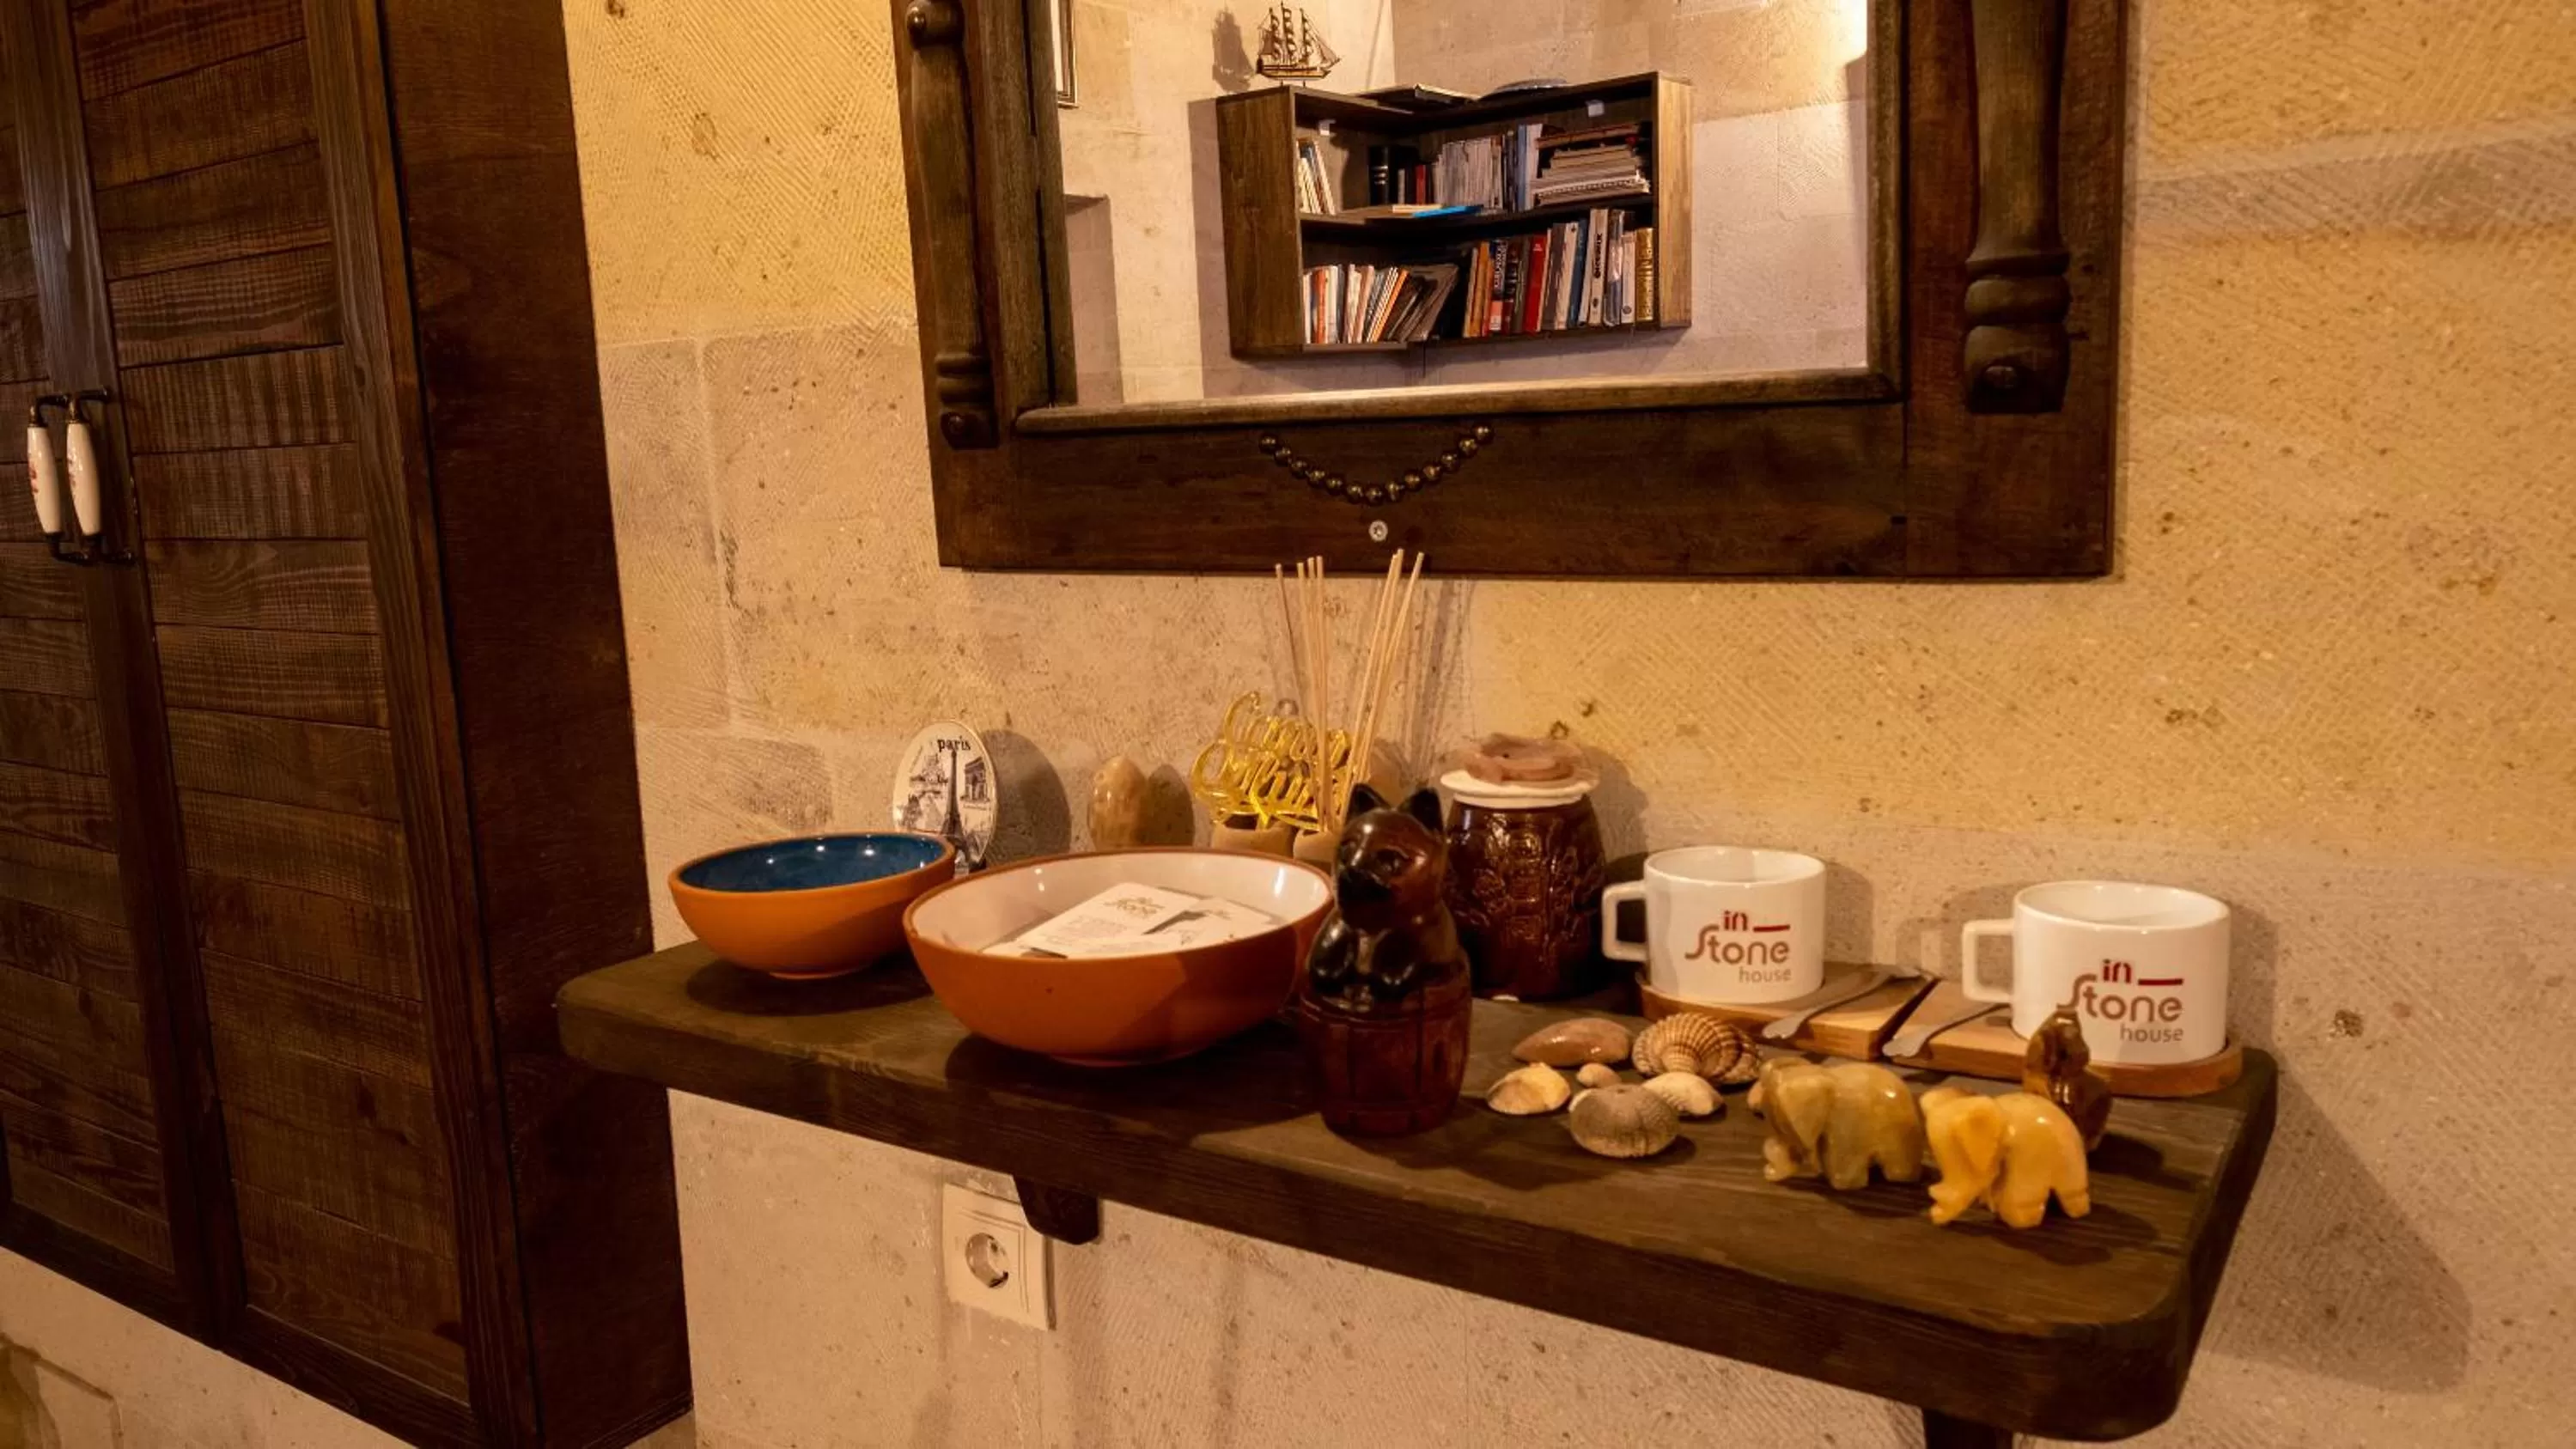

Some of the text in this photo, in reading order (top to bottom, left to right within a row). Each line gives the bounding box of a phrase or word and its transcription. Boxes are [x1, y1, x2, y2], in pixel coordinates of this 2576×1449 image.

[937, 736, 971, 752] paris
[1724, 910, 1748, 931] in
[1684, 924, 1790, 965] Stone
[1739, 966, 1792, 983] house
[2103, 959, 2132, 983] in
[2056, 973, 2183, 1022] Stone
[2120, 1023, 2183, 1043] house
